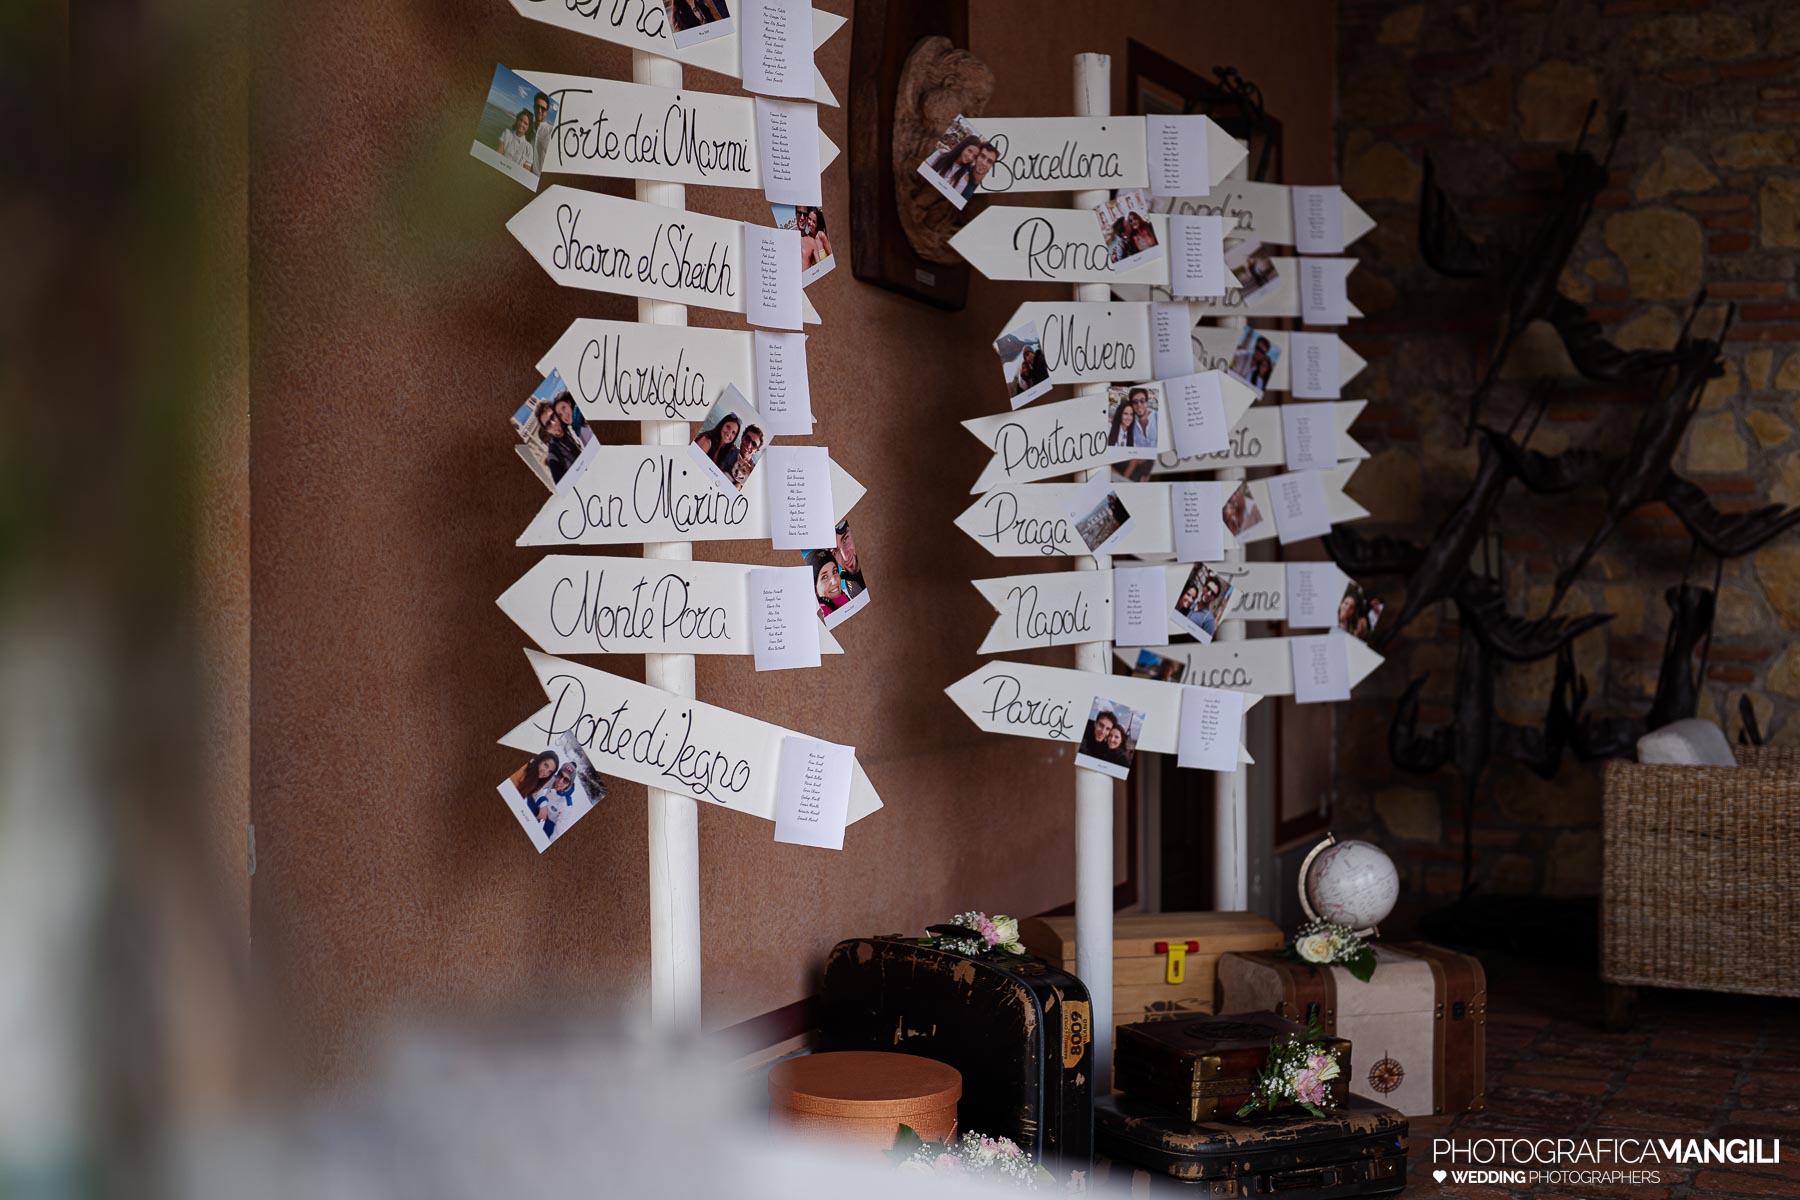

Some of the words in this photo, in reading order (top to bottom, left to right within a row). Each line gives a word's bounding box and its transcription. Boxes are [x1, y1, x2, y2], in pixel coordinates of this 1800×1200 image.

[549, 88, 620, 166] Forte
[624, 113, 661, 166] dei
[663, 101, 752, 176] Marmi
[980, 133, 1123, 192] Barcellona
[552, 204, 633, 279] Sharm
[637, 223, 662, 285] el
[1013, 216, 1116, 279] Roma
[577, 334, 711, 420] Marsiglia
[1042, 313, 1136, 376] Molveno
[994, 418, 1109, 478] Positano
[633, 455, 750, 533] Marino
[977, 491, 1073, 556] Praga
[550, 569, 653, 653] Monte
[652, 573, 732, 643] Pora
[1006, 585, 1092, 647] Napoli
[532, 674, 630, 761] Ponte
[632, 708, 666, 768] di
[660, 708, 752, 804] Legno
[982, 674, 1074, 740] Parigi
